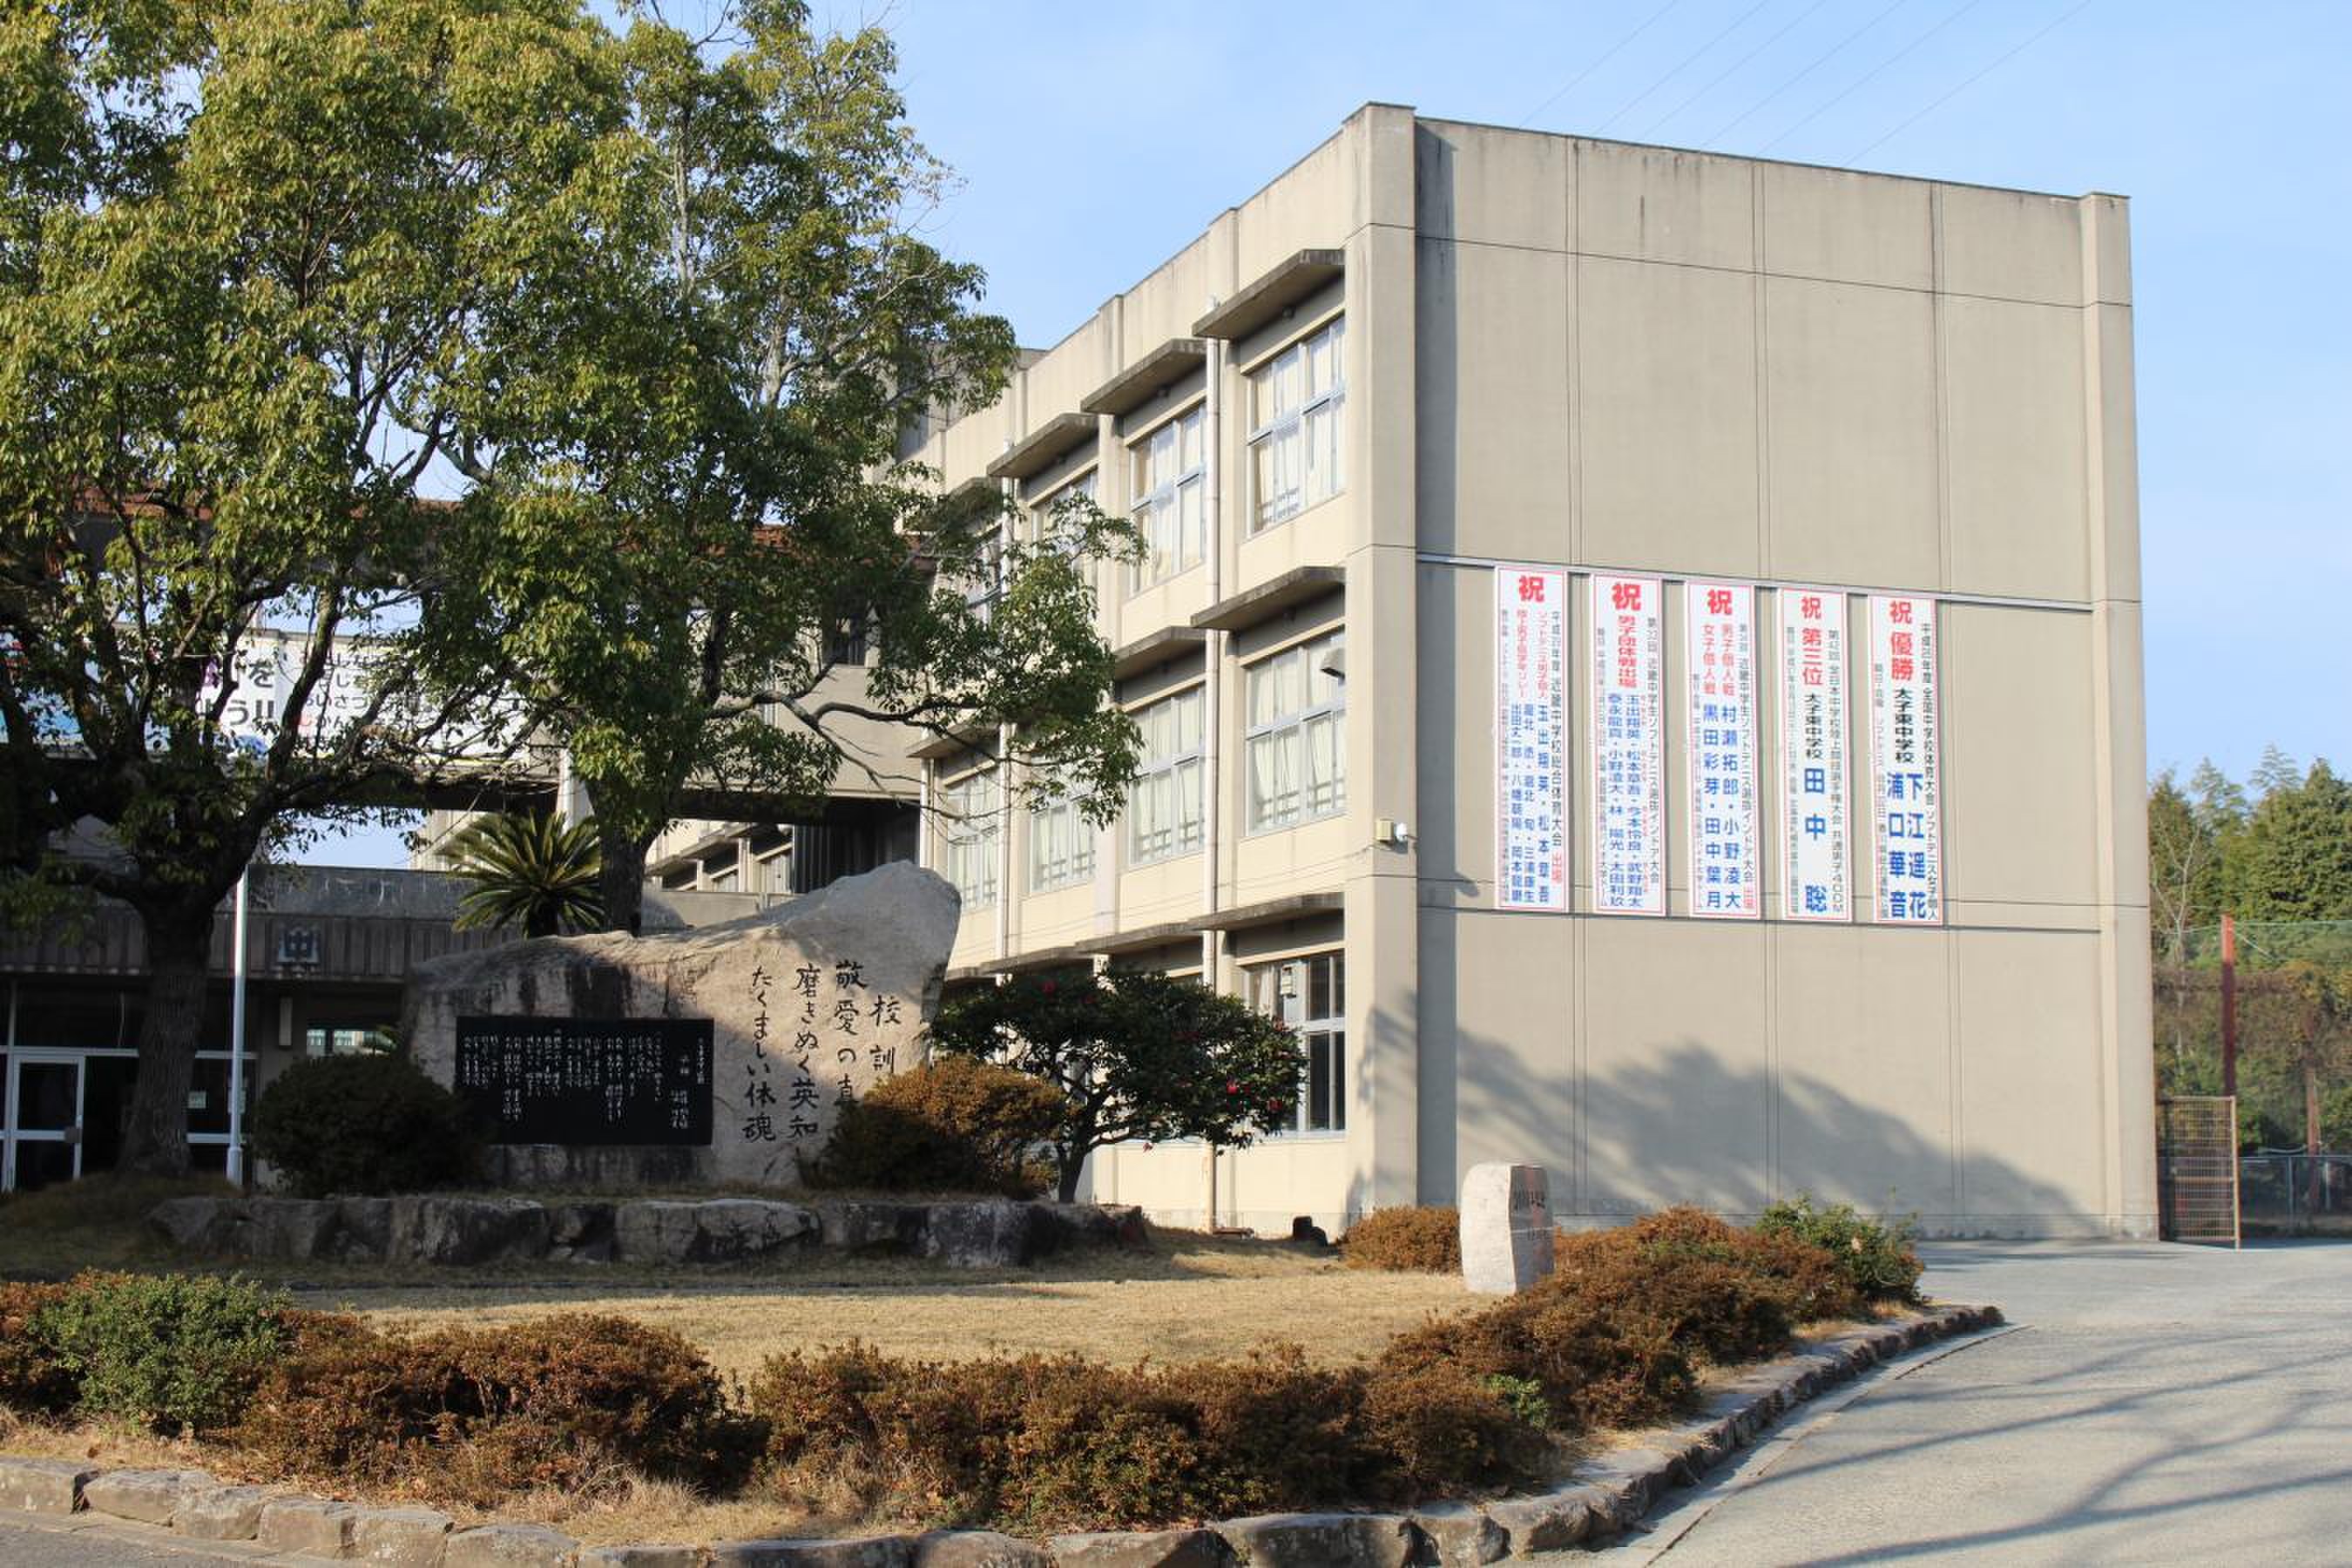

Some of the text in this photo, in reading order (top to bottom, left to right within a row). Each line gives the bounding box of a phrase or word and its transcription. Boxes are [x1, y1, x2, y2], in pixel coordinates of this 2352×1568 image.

[1518, 575, 1545, 602] 祝
[1612, 582, 1641, 611] 祝
[1707, 589, 1733, 615] 祝
[1801, 596, 1824, 686] 祝 第三位
[1889, 600, 1914, 681] 祝 優勝
[788, 963, 821, 1138] 磨きぬく英知
[870, 994, 902, 1074] 校訓
